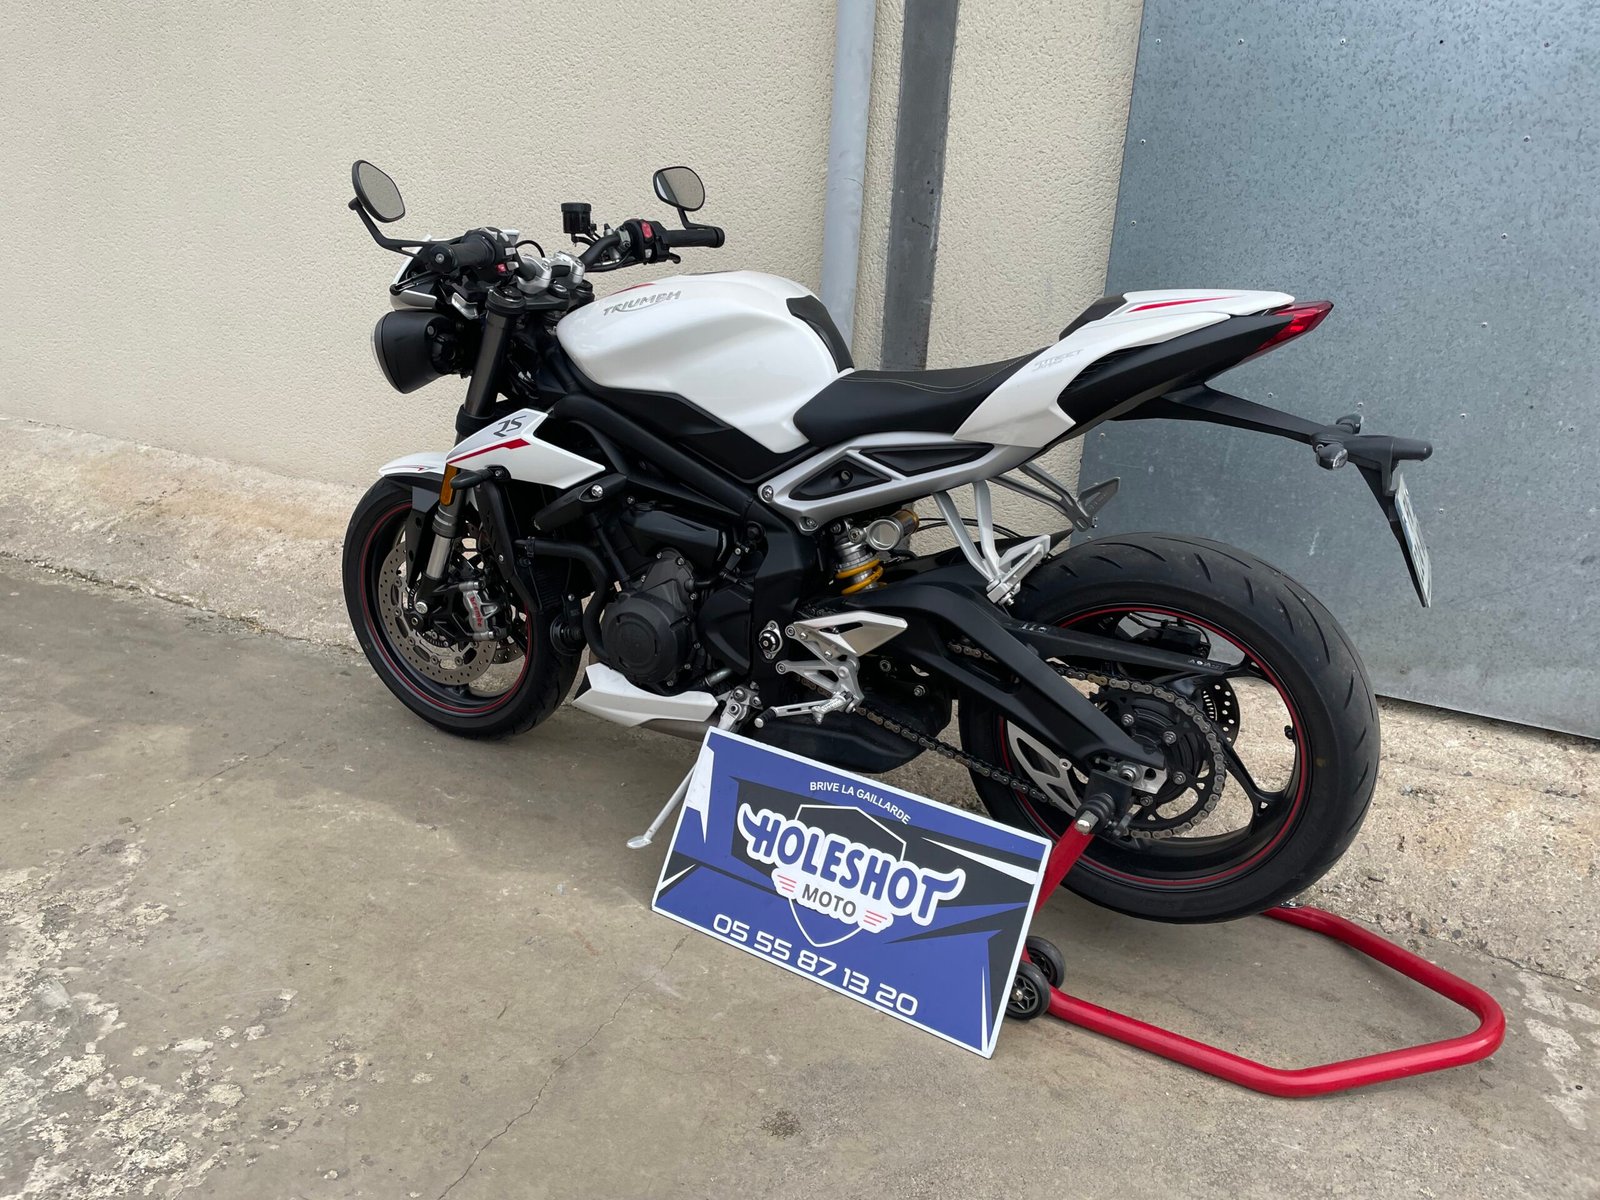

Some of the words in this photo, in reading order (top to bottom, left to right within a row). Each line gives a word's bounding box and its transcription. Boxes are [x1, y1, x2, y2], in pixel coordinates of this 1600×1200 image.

[603, 290, 682, 317] TRIUMPH
[809, 781, 840, 793] BRIVE
[841, 784, 855, 796] LA
[856, 789, 912, 825] GAILLARDE
[742, 810, 960, 920] HOLESHOT
[801, 883, 857, 918] MOTO
[713, 913, 750, 942] 05
[754, 930, 793, 961] 55
[797, 949, 837, 976] 87
[842, 967, 870, 995] 13
[875, 982, 919, 1016] 20
